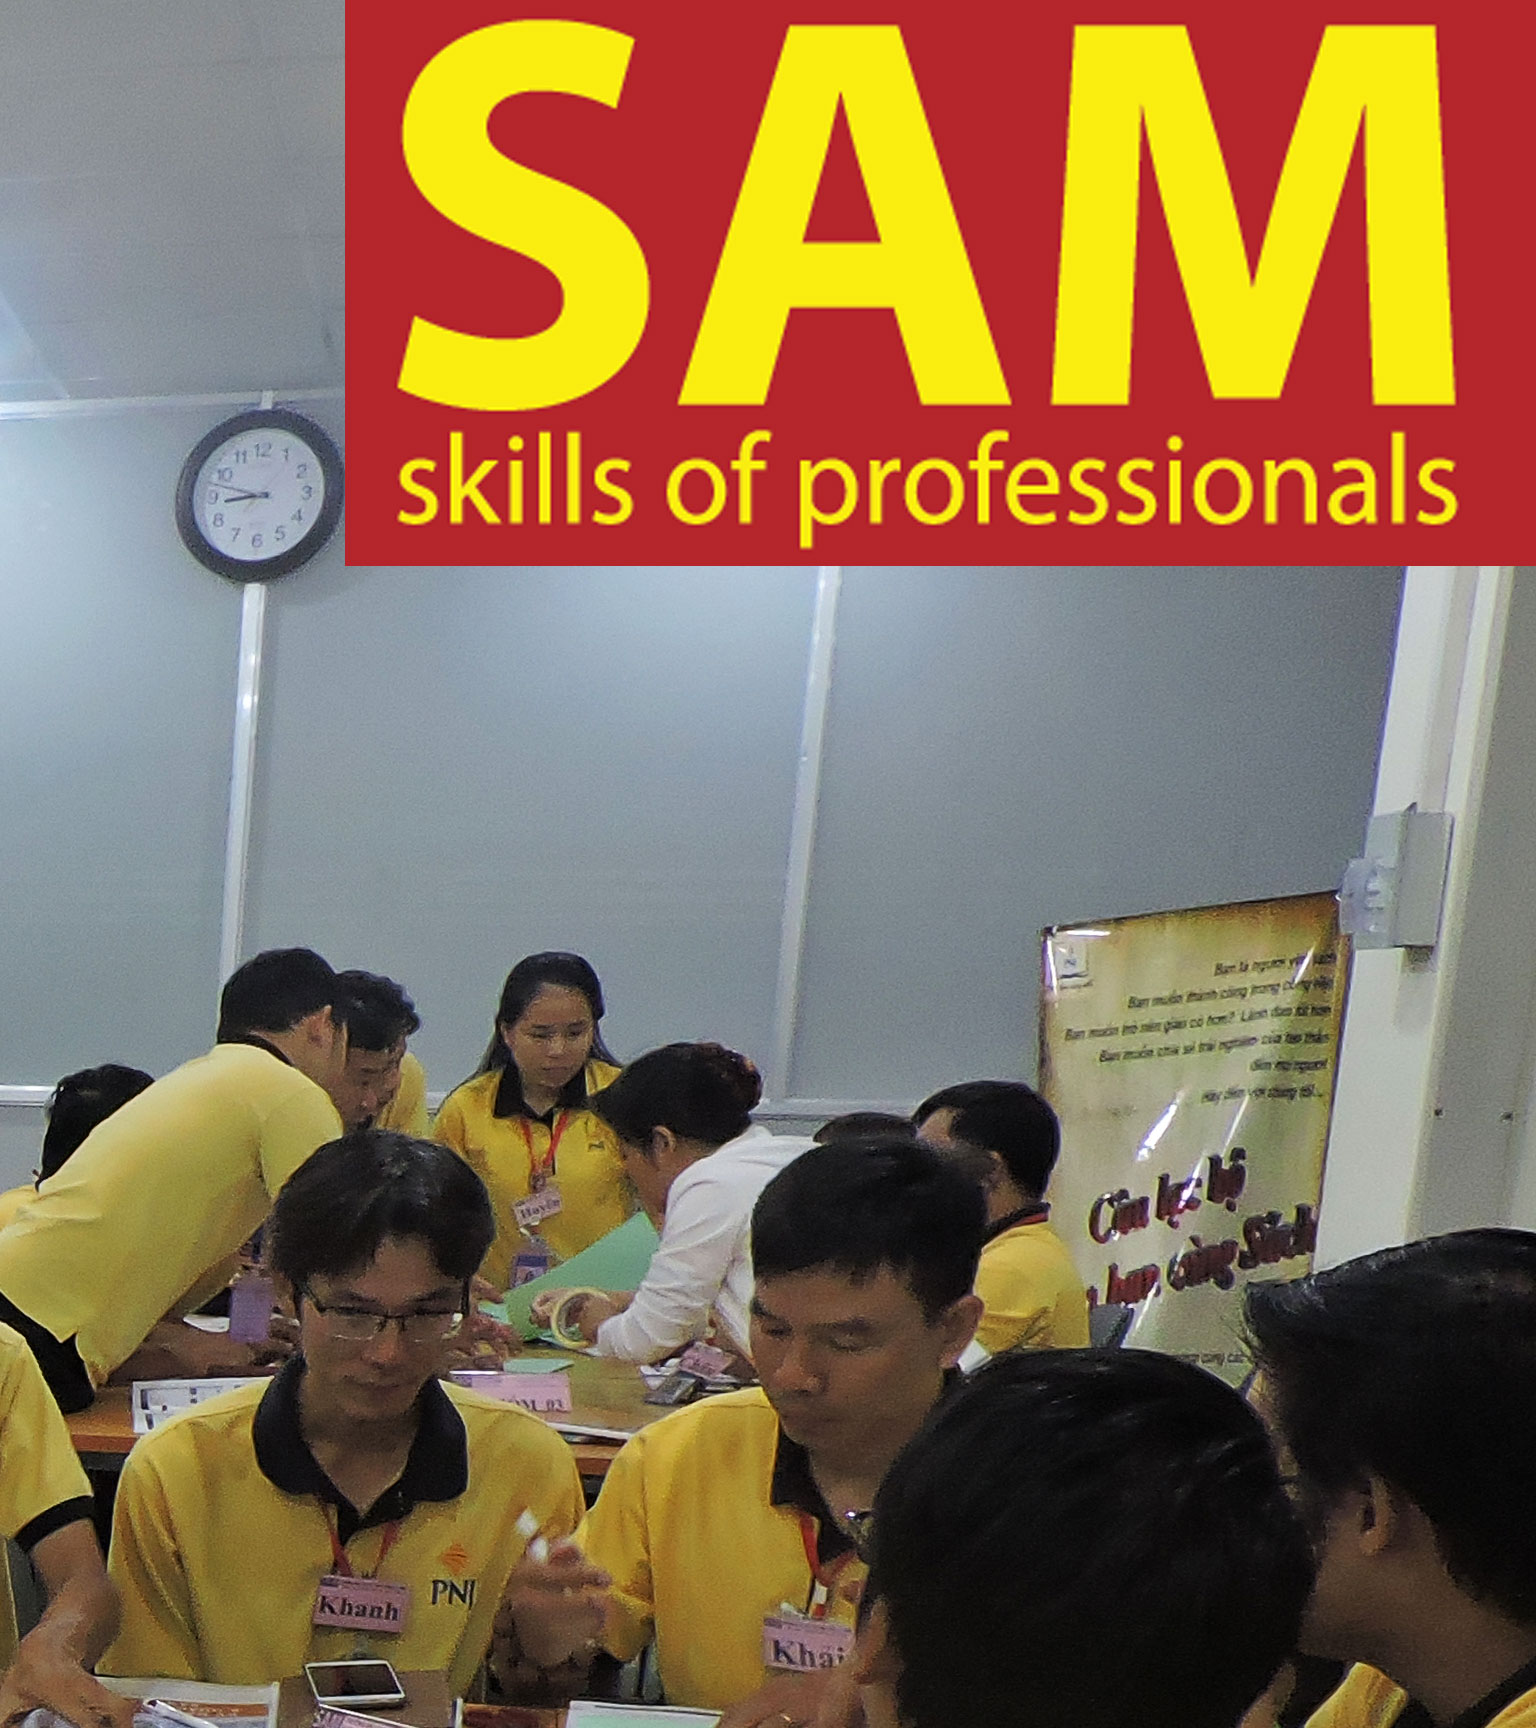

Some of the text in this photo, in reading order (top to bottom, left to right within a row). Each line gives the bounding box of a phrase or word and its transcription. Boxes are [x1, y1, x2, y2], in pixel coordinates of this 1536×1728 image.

[234, 451, 248, 465] 11
[254, 442, 273, 459] 12
[281, 447, 290, 461] 1
[217, 467, 234, 482] 10
[296, 464, 307, 479] 2
[208, 489, 219, 505] 9
[302, 485, 313, 501] 3
[213, 512, 225, 528] 8
[291, 508, 303, 523] 4
[231, 527, 242, 542] 7
[251, 533, 263, 549] 6
[275, 525, 286, 541] 5
[431, 1578, 477, 1611] PNJ
[318, 1595, 399, 1622] Khanh
